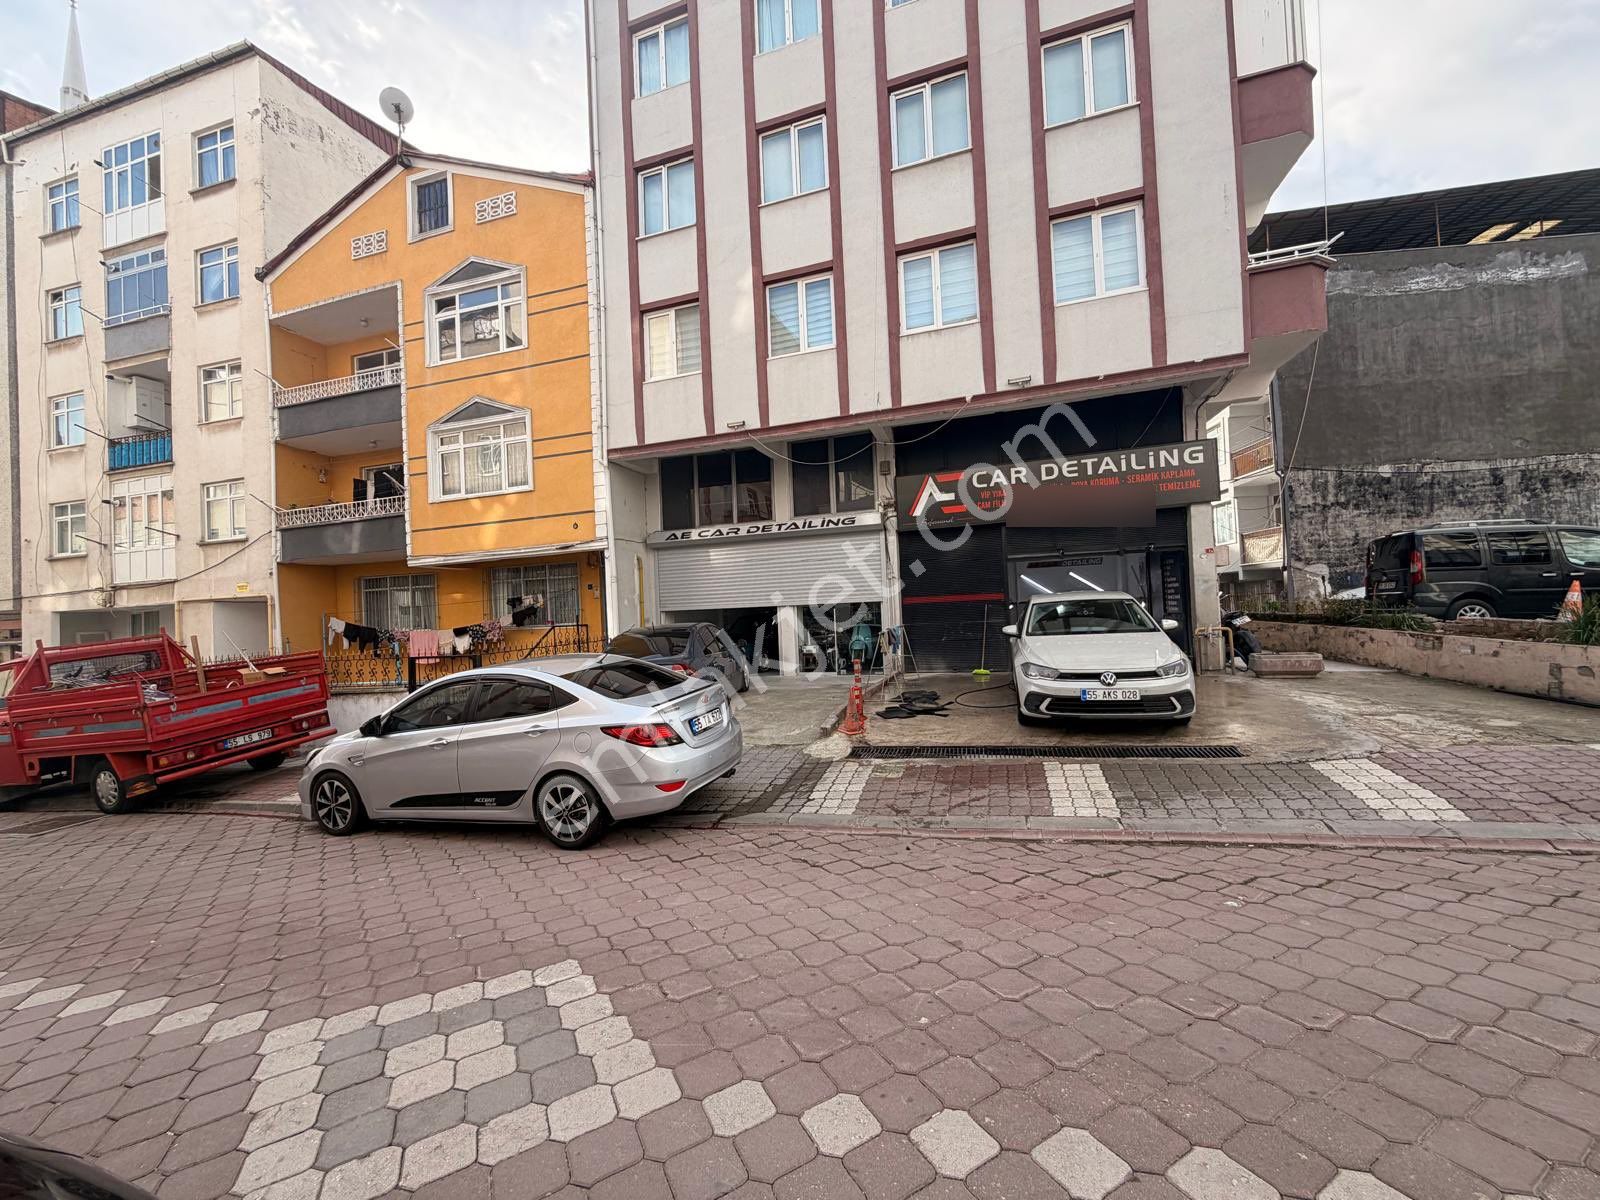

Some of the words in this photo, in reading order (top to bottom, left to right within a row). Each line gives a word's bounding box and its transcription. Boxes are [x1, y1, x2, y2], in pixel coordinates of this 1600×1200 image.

[972, 467, 1028, 488] CAR
[1090, 477, 1120, 487] KORUMA
[1160, 469, 1196, 480] KAPLAMA
[665, 531, 691, 541] AE
[697, 527, 741, 538] CAR
[1088, 690, 1098, 699] 55
[1102, 690, 1118, 699] AKS
[1121, 690, 1138, 699] 028
[228, 738, 238, 747] 55
[243, 734, 253, 743] LS
